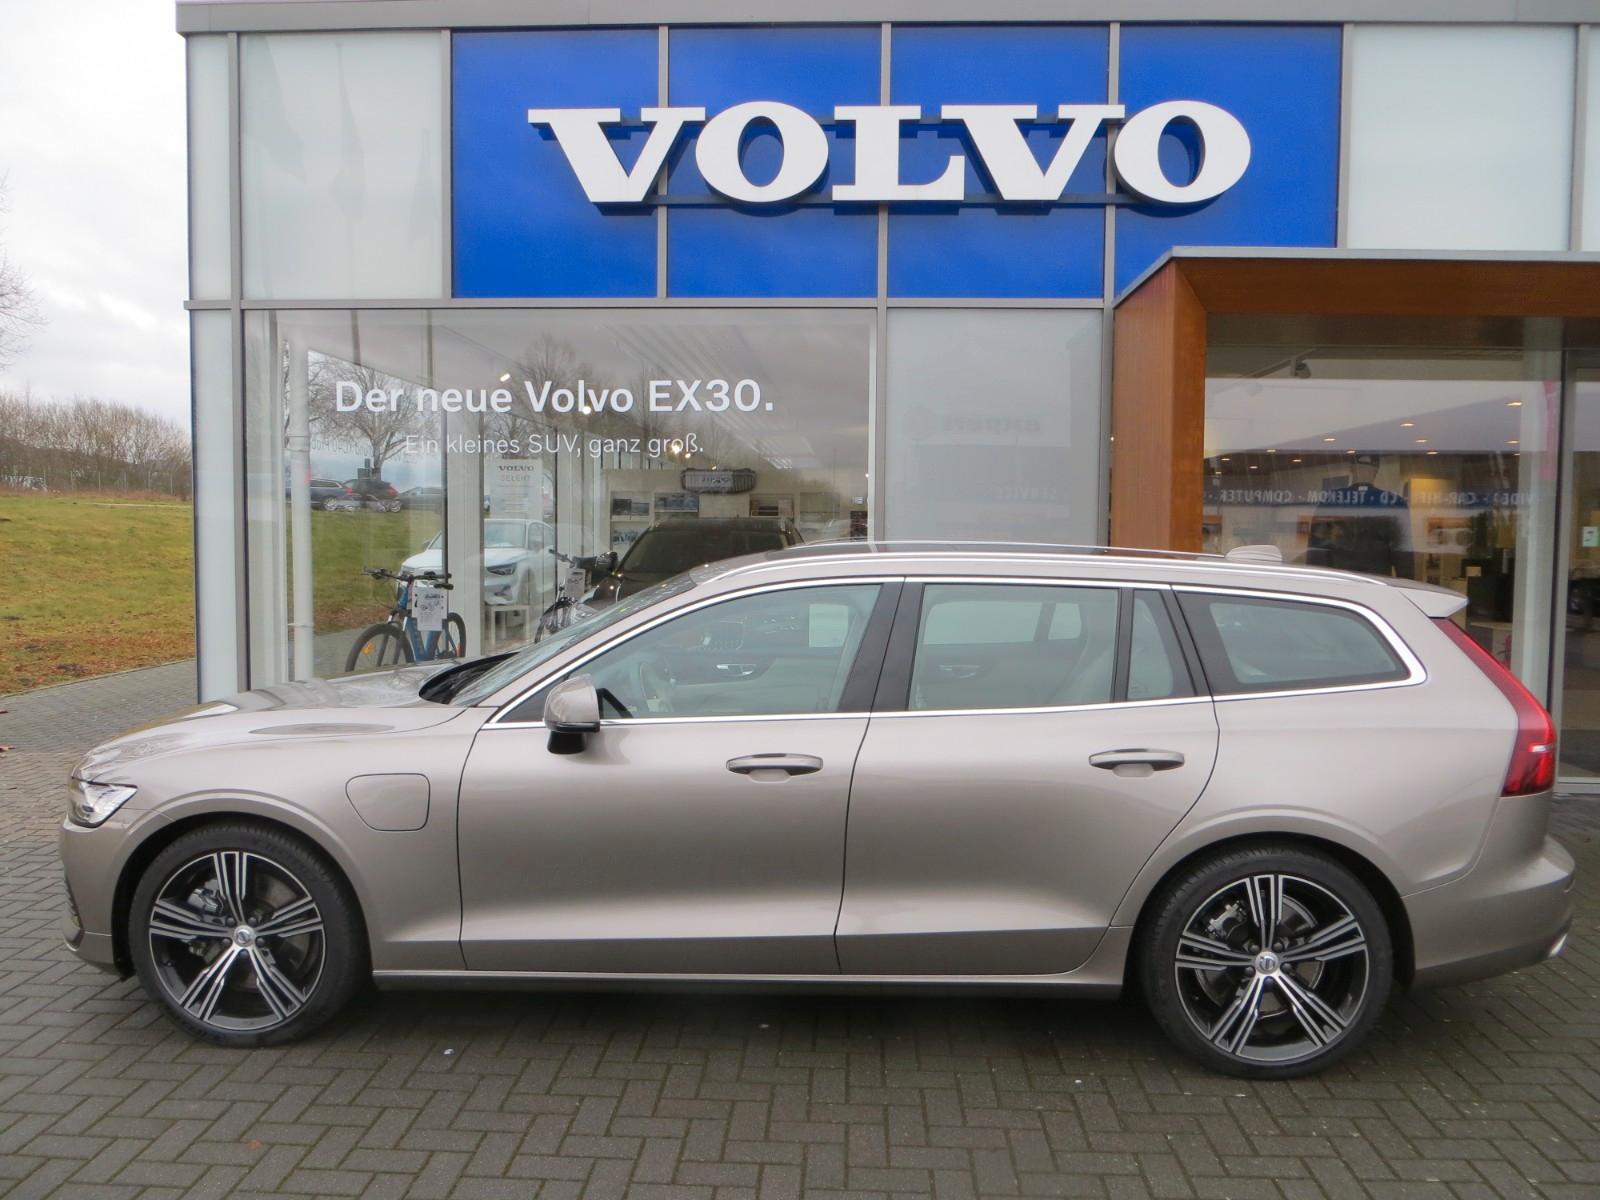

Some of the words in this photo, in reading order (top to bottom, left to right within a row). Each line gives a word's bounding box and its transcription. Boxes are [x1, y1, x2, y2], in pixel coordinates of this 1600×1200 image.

[528, 101, 1251, 202] VOLVO
[335, 381, 402, 412] Der
[418, 387, 512, 413] neue
[525, 380, 633, 413] Volvo
[649, 378, 774, 412] EX30.
[405, 435, 438, 454] Ein
[446, 433, 520, 454] kleines
[528, 434, 581, 457] SUV,
[588, 439, 641, 458] ganz
[648, 433, 704, 458] groß.
